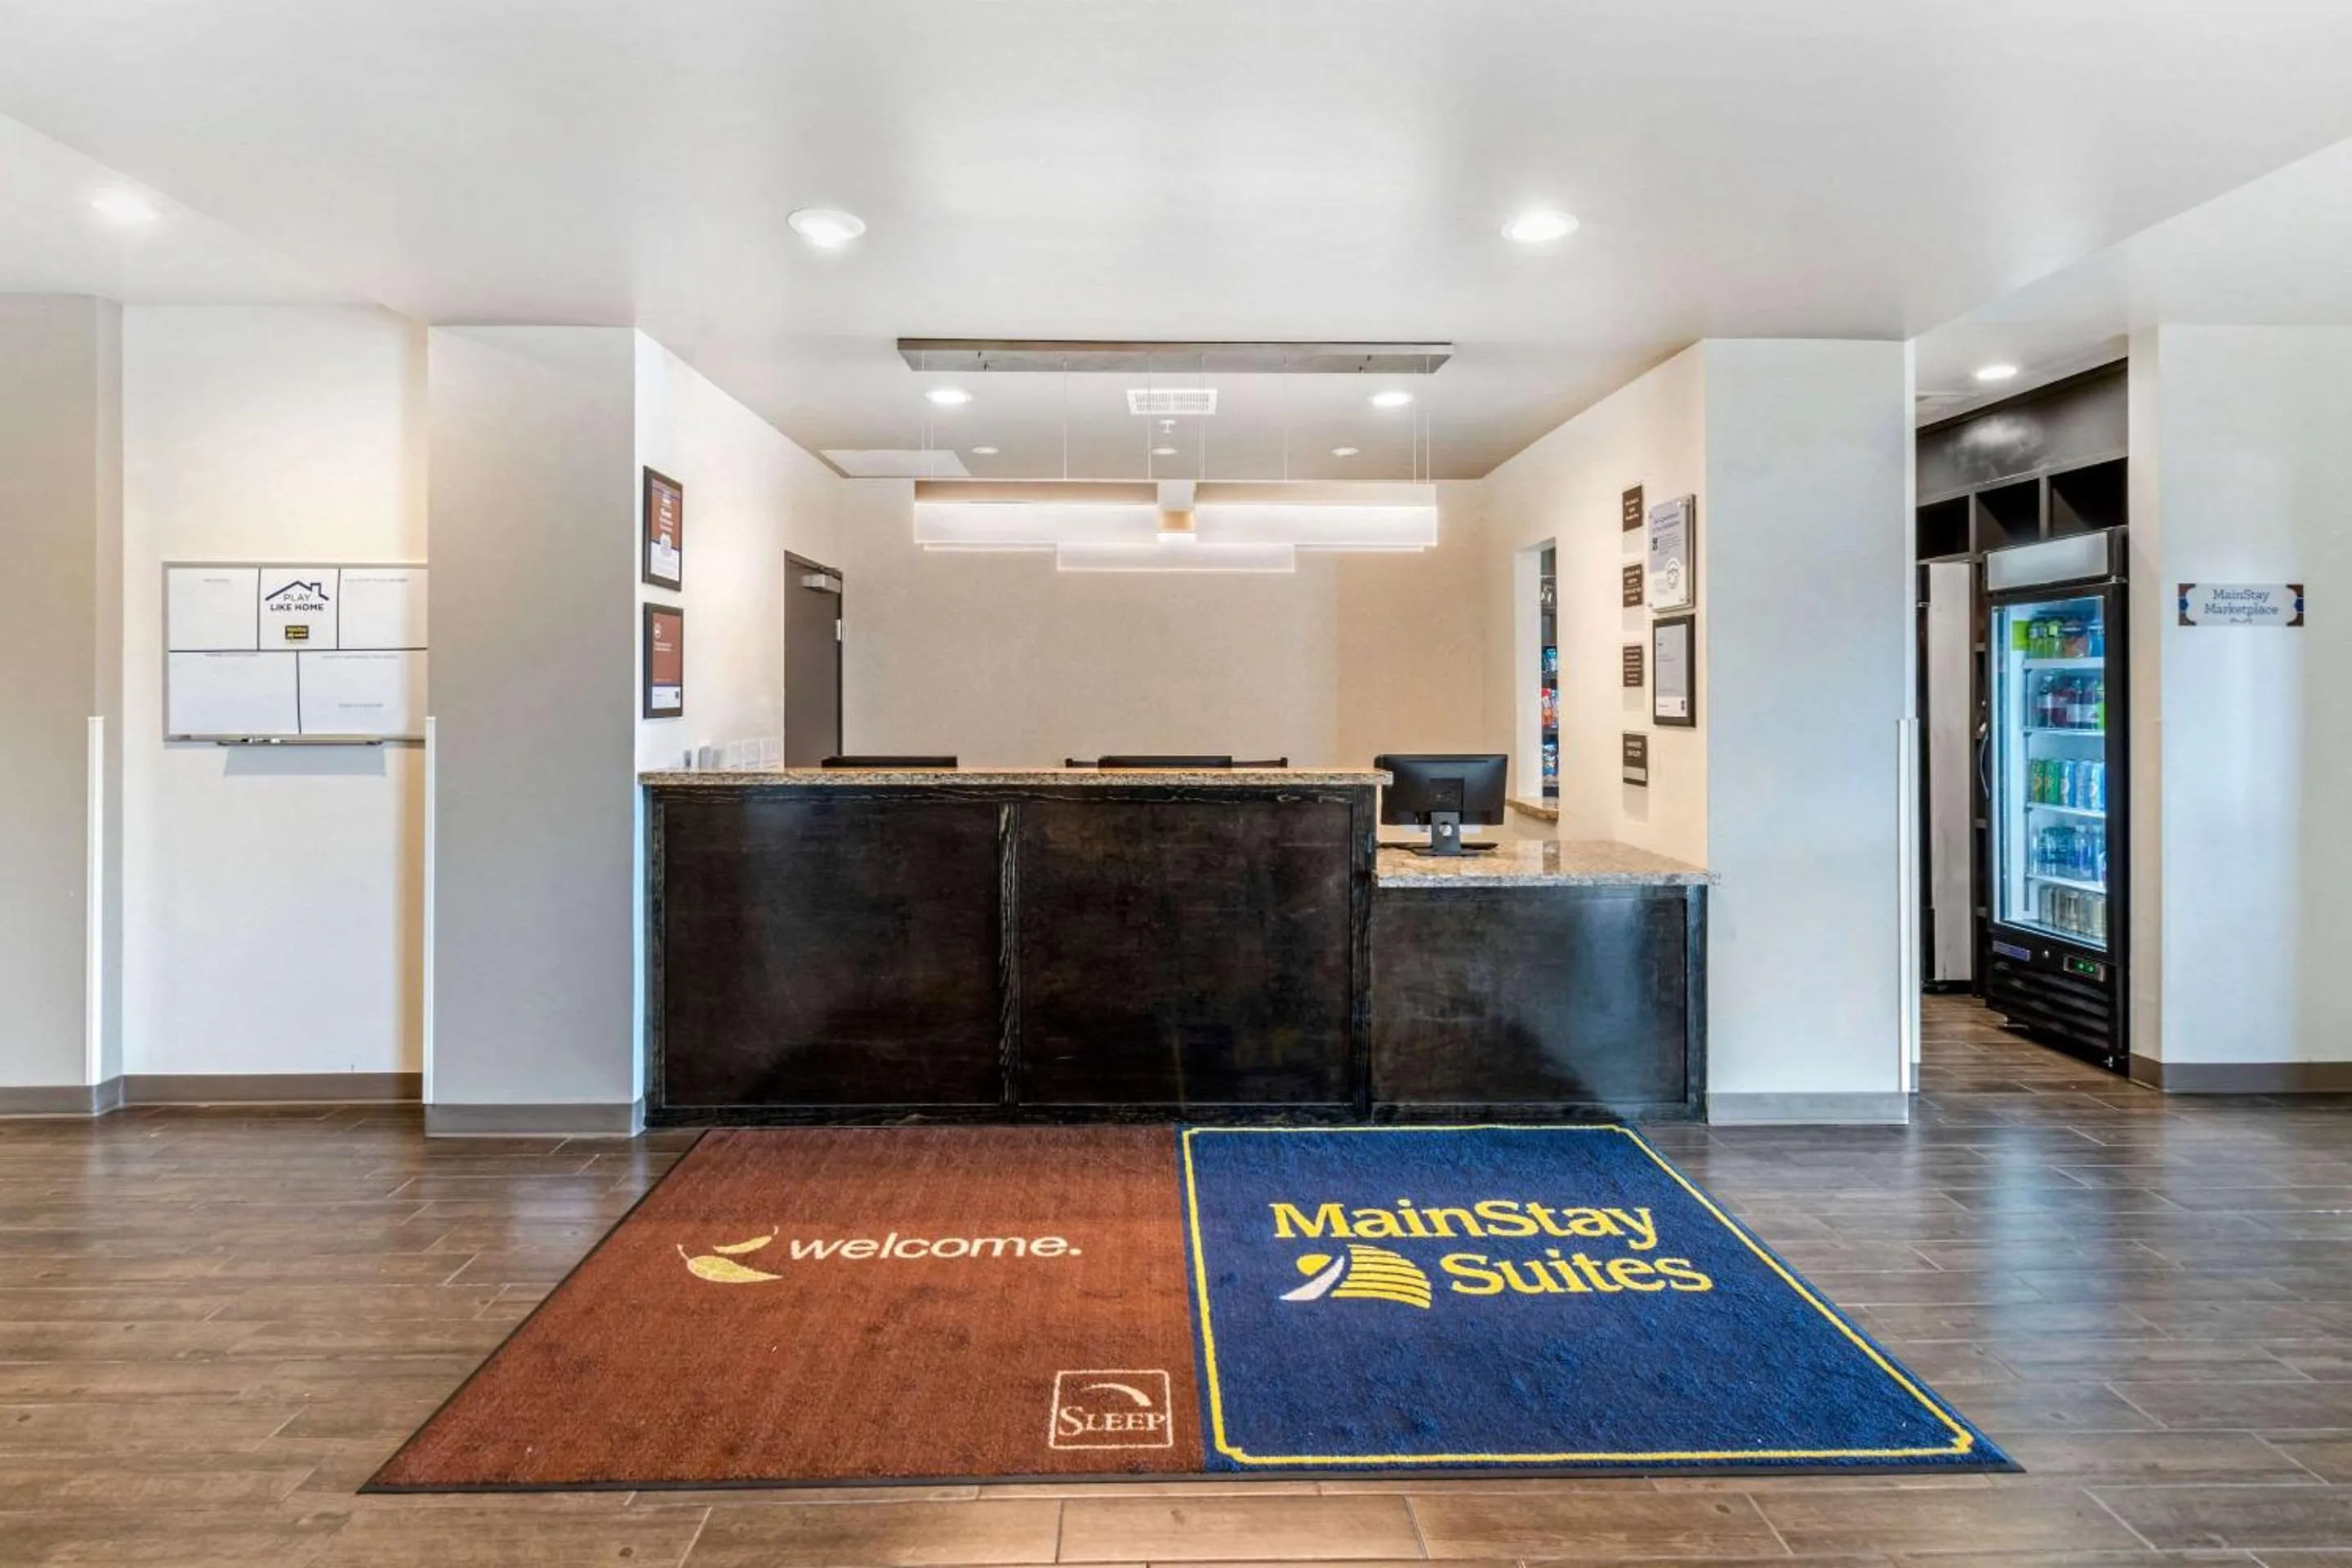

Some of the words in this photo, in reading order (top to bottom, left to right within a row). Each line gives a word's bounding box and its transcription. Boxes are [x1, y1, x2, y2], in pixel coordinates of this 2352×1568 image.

[283, 594, 310, 602] PLAY
[2212, 588, 2270, 603] MainStay
[2204, 603, 2278, 617] Marketplace
[1268, 1198, 1658, 1250] MainStay
[790, 1232, 1082, 1259] welcome.
[1438, 1248, 1713, 1295] Suites
